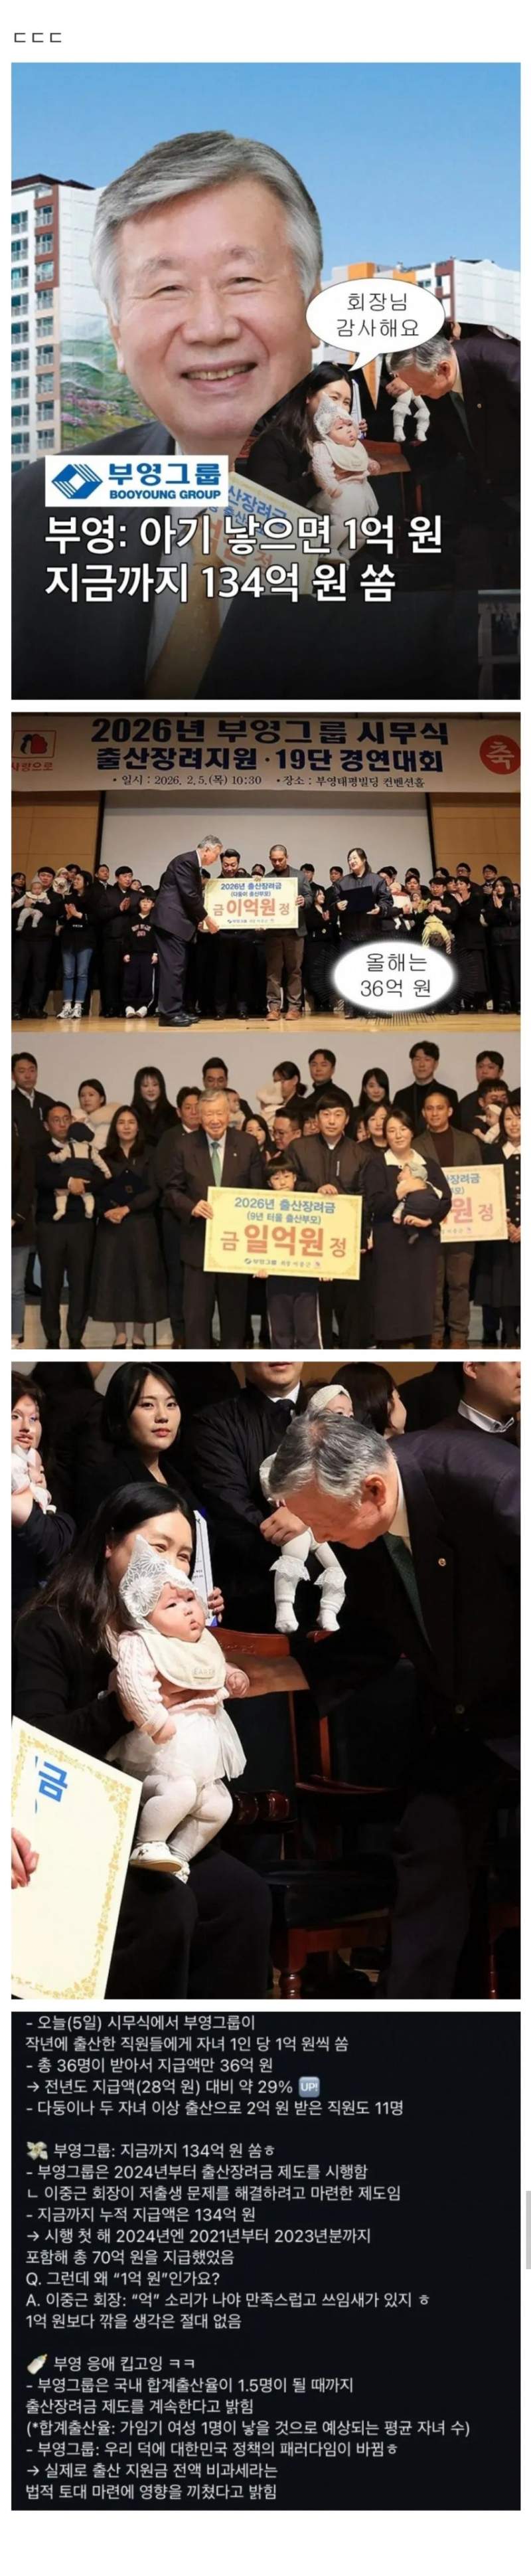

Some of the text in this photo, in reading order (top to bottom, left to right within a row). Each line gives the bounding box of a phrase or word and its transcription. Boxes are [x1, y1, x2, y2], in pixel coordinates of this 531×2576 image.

[91, 717, 449, 745] 2026년 부영그룹 시무식
[96, 747, 443, 773] 출산장려지원 19단 경연대회
[485, 741, 516, 771] 축
[154, 775, 182, 786] 2026.
[232, 775, 262, 785] 10:30
[315, 776, 379, 788] 부영태평빌딩
[383, 777, 425, 788] 컨벤션홀
[212, 898, 290, 917] 금 이억원 정
[235, 1197, 336, 1214] 2026년 출산장려금
[478, 1203, 494, 1222] 정
[246, 1212, 321, 1225] (9년 터울 출산부모)
[220, 1224, 346, 1258] 금 일억원 정
[36, 1756, 68, 1802] 금
